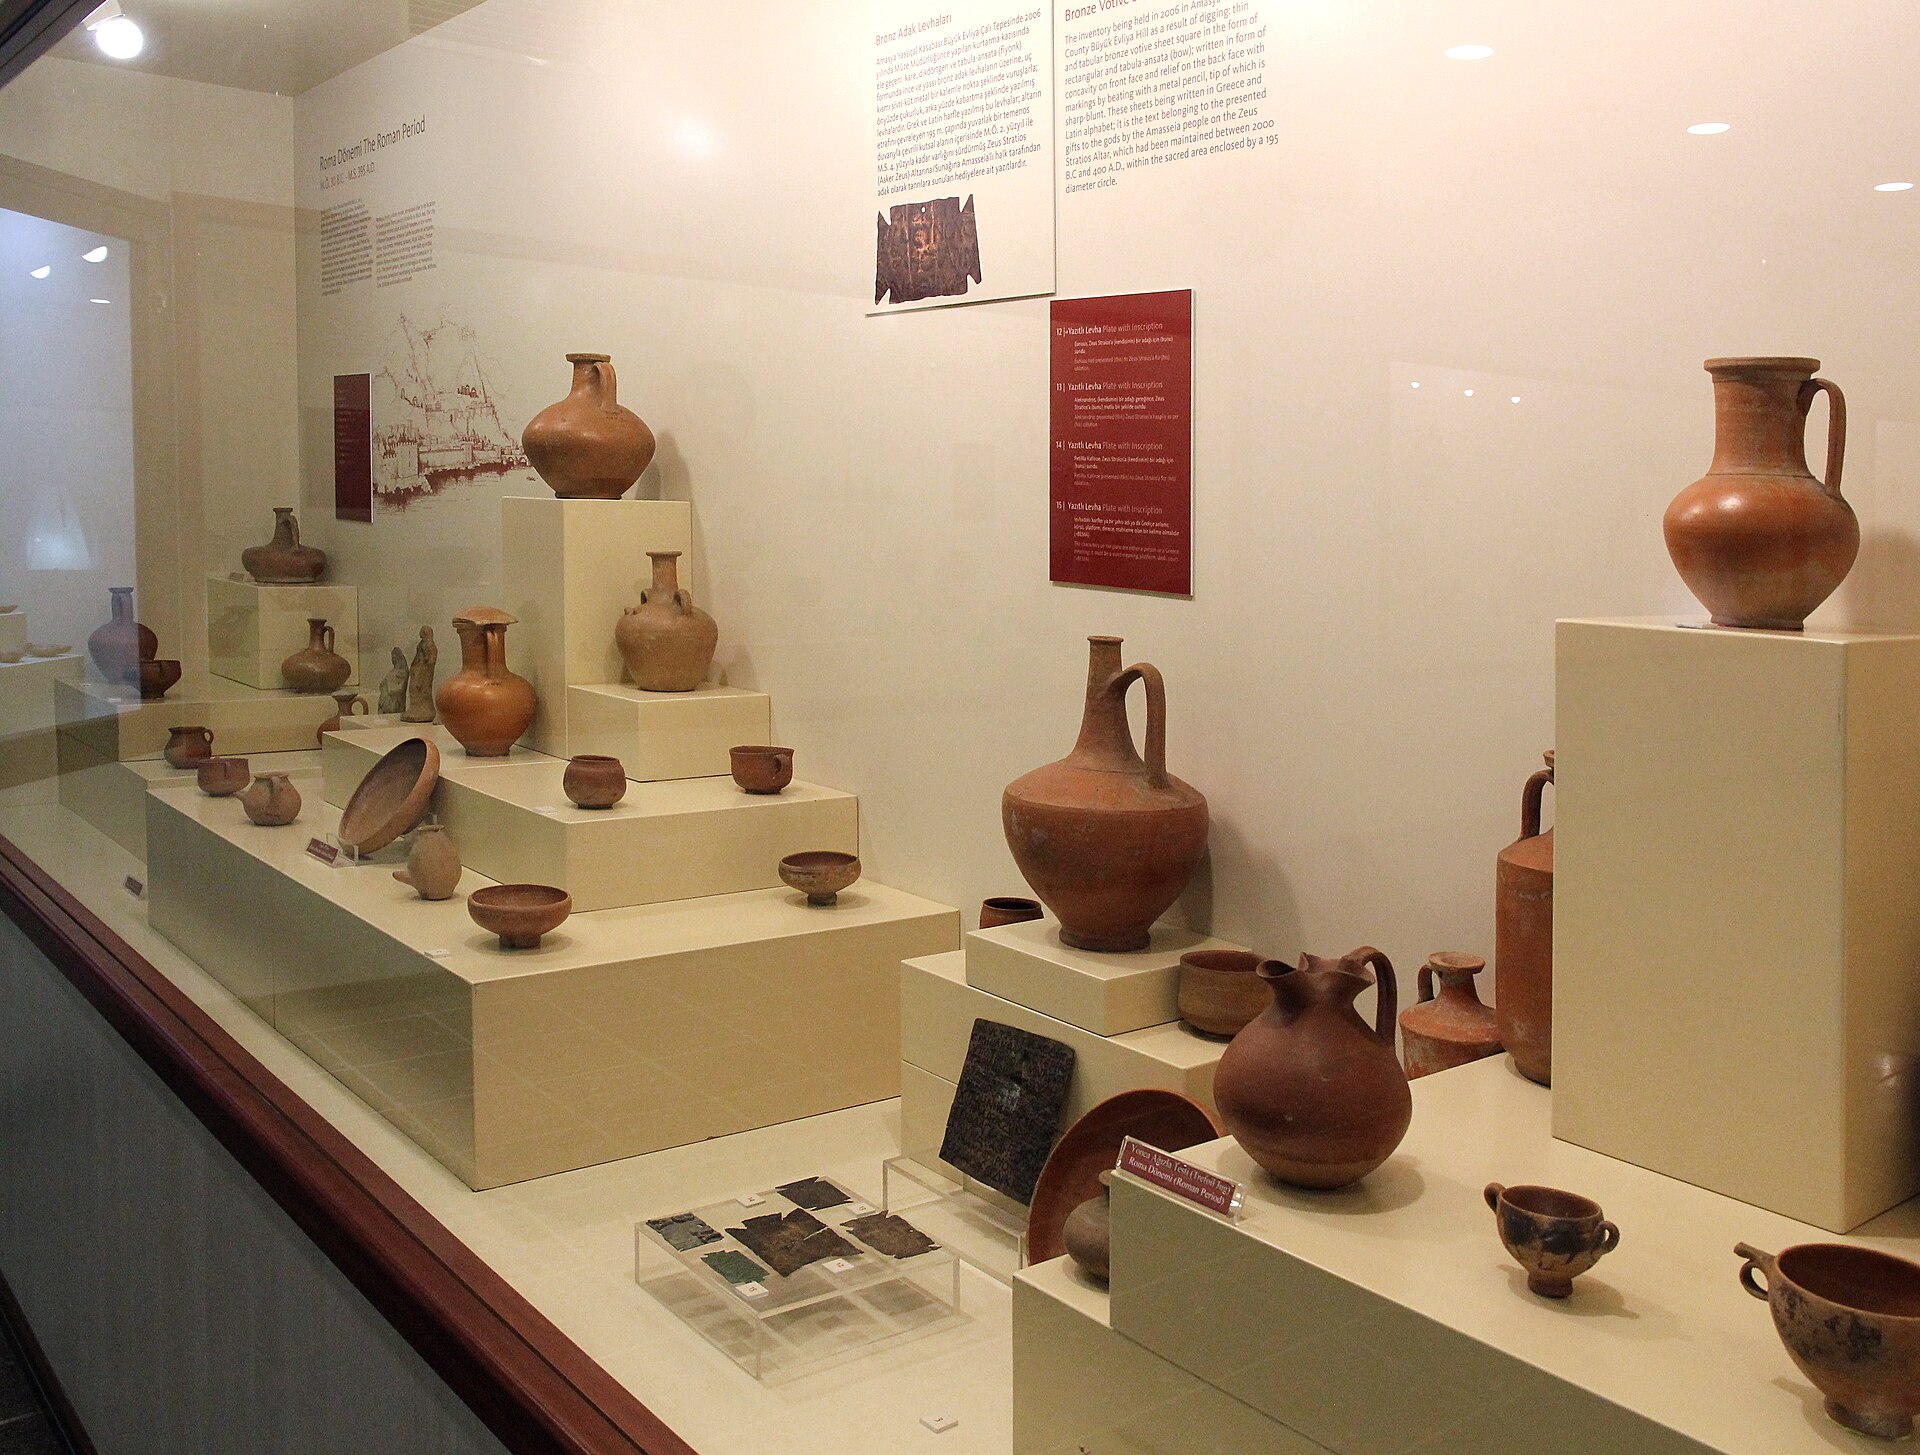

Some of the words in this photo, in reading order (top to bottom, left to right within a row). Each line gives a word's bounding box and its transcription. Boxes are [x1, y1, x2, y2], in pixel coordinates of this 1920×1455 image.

[876, 32, 896, 46] Bronz
[898, 23, 916, 39] Adak
[918, 14, 951, 33] Levhaları
[1065, 3, 1096, 22] Bronze
[1065, 34, 1077, 45] The
[1078, 25, 1112, 41] inventory
[1112, 20, 1132, 32] being
[1134, 12, 1150, 26] held
[1151, 11, 1159, 21] in
[1160, 4, 1180, 19] 2006
[1181, 3, 1189, 13] in
[1065, 45, 1089, 58] County
[1090, 37, 1112, 52] Büyük
[1114, 33, 1134, 46] Evliya
[1136, 27, 1149, 40] Hill
[1150, 27, 1158, 36] as
[1160, 25, 1164, 33] a
[1166, 17, 1187, 32] result
[1190, 14, 1198, 26] of
[1199, 7, 1230, 24] digging:
[1232, 1, 1248, 14] thin
[1065, 60, 1078, 72] and
[1079, 55, 1103, 69] tabular
[1104, 49, 1129, 62] bronze
[1130, 43, 1152, 56] votive
[1154, 36, 1174, 49] sheet
[1176, 30, 1201, 46] square
[1203, 26, 1210, 37] in
[1212, 22, 1226, 34] the
[1228, 18, 1247, 30] form
[1249, 13, 1257, 25] of
[1065, 69, 1103, 86] rectangular
[1105, 63, 1118, 76] and
[1120, 53, 1168, 72] tabula-ansata
[1170, 45, 1194, 63] (bow);
[1196, 39, 1224, 53] written
[1226, 35, 1234, 46] in
[1235, 31, 1255, 44] form
[1257, 26, 1266, 38] of
[1065, 84, 1097, 99] concavity
[1098, 82, 1108, 91] on
[1109, 76, 1126, 89] front
[1128, 74, 1144, 84] face
[1145, 67, 1158, 80] and
[1160, 62, 1180, 76] relief
[1181, 62, 1191, 72] on
[1193, 57, 1206, 69] the
[1208, 51, 1226, 65] back
[1228, 49, 1245, 60] face
[1246, 42, 1264, 56] with
[1066, 99, 1096, 113] markings
[1097, 95, 1105, 108] by
[1107, 90, 1134, 103] beating
[1135, 84, 1152, 97] with
[1153, 85, 1158, 93] a
[1159, 77, 1181, 91] metal
[1182, 71, 1208, 89] pencil,
[1210, 68, 1221, 82] tip
[1222, 65, 1231, 77] of
[1232, 59, 1256, 74] which
[1258, 58, 1265, 68] is
[1066, 110, 1106, 126] sharp-blunt.
[1108, 106, 1128, 117] These
[1130, 100, 1153, 112] sheets
[1154, 95, 1175, 107] being
[1177, 88, 1205, 102] written
[1206, 85, 1214, 95] in
[1216, 80, 1245, 93] Greece
[1246, 73, 1262, 87] and
[1066, 128, 1082, 140] Latin
[1083, 122, 1116, 138] alphabet;
[1117, 119, 1122, 129] it
[1124, 118, 1130, 127] is
[1131, 115, 1143, 126] the
[1145, 112, 1160, 123] text
[1161, 104, 1199, 120] belonging
[1200, 102, 1209, 111] to
[1210, 98, 1224, 109] the
[1226, 87, 1266, 109] presented
[320, 154, 336, 171] Roma
[338, 141, 362, 165] Dönemi
[364, 137, 375, 154] The
[377, 129, 400, 149] Roman
[402, 114, 425, 139] Period
[1066, 142, 1080, 156] gifts
[1082, 142, 1089, 150] to
[1090, 138, 1102, 148] the
[1104, 134, 1120, 149] gods
[1122, 132, 1130, 144] by
[1132, 129, 1145, 140] the
[1146, 121, 1181, 137] Amasseia
[1182, 116, 1209, 133] people
[1210, 115, 1221, 124] on
[1223, 110, 1236, 122] the
[1238, 107, 1257, 119] Zeus
[1066, 154, 1091, 167] Stratios
[1093, 151, 1112, 161] Altar,
[1113, 144, 1134, 158] which
[1135, 141, 1149, 153] had
[1150, 140, 1169, 150] been
[1170, 128, 1214, 146] maintained
[1215, 124, 1250, 138] between
[1252, 119, 1274, 131] 2000
[1066, 169, 1077, 180] B.C
[1078, 166, 1091, 178] and
[1092, 166, 1107, 178] 400
[1108, 161, 1125, 172] A.D.,
[1126, 156, 1149, 169] within
[1151, 154, 1163, 165] the
[1164, 148, 1189, 162] sacred
[1191, 147, 1208, 157] area
[1209, 137, 1245, 154] enclosed
[1246, 136, 1257, 150] by
[1258, 136, 1264, 145] a
[1264, 134, 1278, 146] 195
[1066, 182, 1096, 194] diameter
[1097, 177, 1117, 188] circle.
[1085, 326, 1101, 334] Levha
[1103, 324, 1116, 332] Plate
[1132, 322, 1162, 331] Inscription
[1132, 381, 1162, 390] Inscription
[1085, 442, 1101, 450] Levha
[1103, 442, 1116, 450] Plate
[1118, 442, 1130, 450] with
[1132, 442, 1162, 451] Inscription
[1085, 502, 1101, 511] Levha
[1103, 504, 1116, 512] Plate
[1132, 504, 1162, 515] Inscription
[1129, 1157, 1147, 1172] Roma
[1148, 1165, 1173, 1182] Dönemi
[1132, 1144, 1150, 1159] Yonca
[1174, 1163, 1190, 1176] Testi
